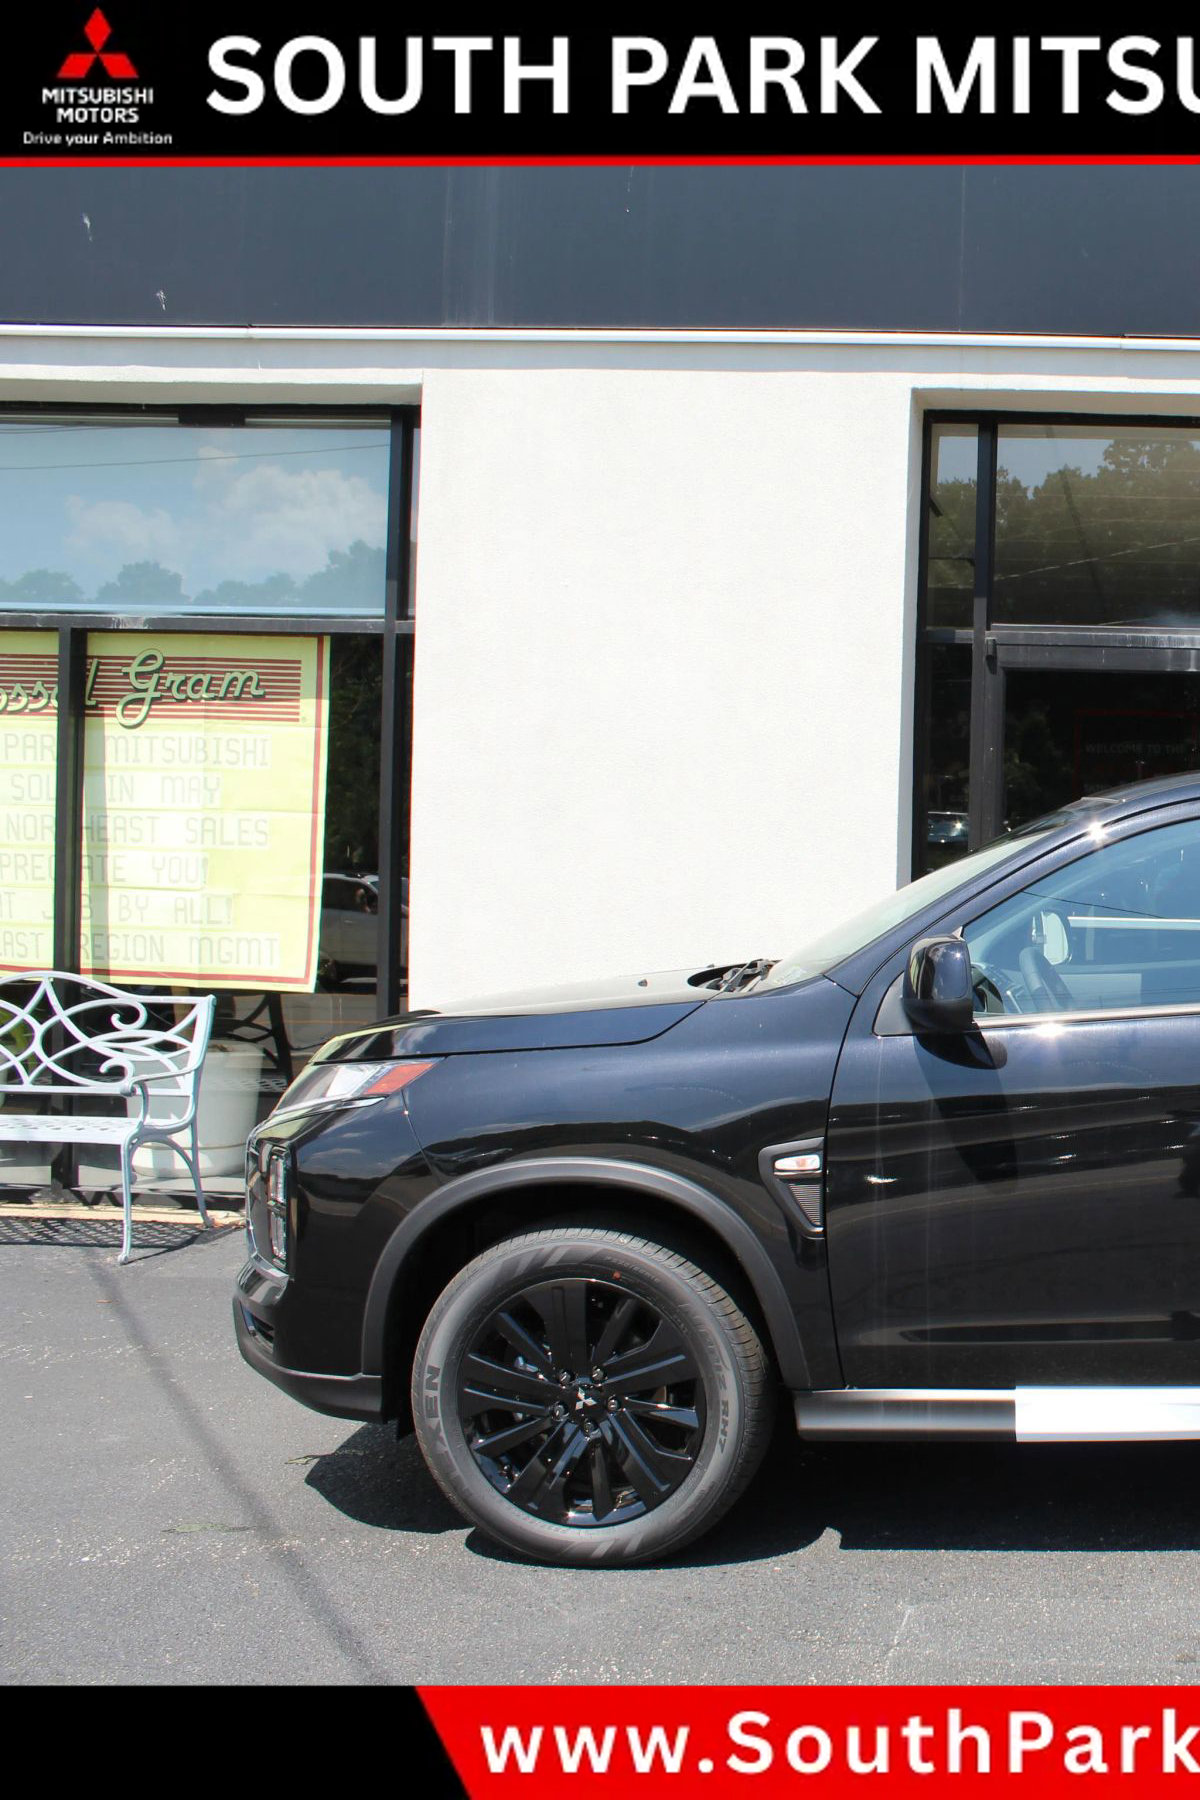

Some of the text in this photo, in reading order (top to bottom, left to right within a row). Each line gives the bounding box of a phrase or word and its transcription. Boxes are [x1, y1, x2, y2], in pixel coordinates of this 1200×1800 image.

[115, 648, 267, 728] Gram
[4, 733, 269, 767] PAR MITSUBISHI
[11, 773, 221, 805] SOL IN MAY
[184, 817, 269, 847] SALES
[151, 855, 209, 885] YOU!
[118, 894, 150, 924] BY
[173, 897, 233, 925] ALL!
[188, 936, 279, 966] MGMT
